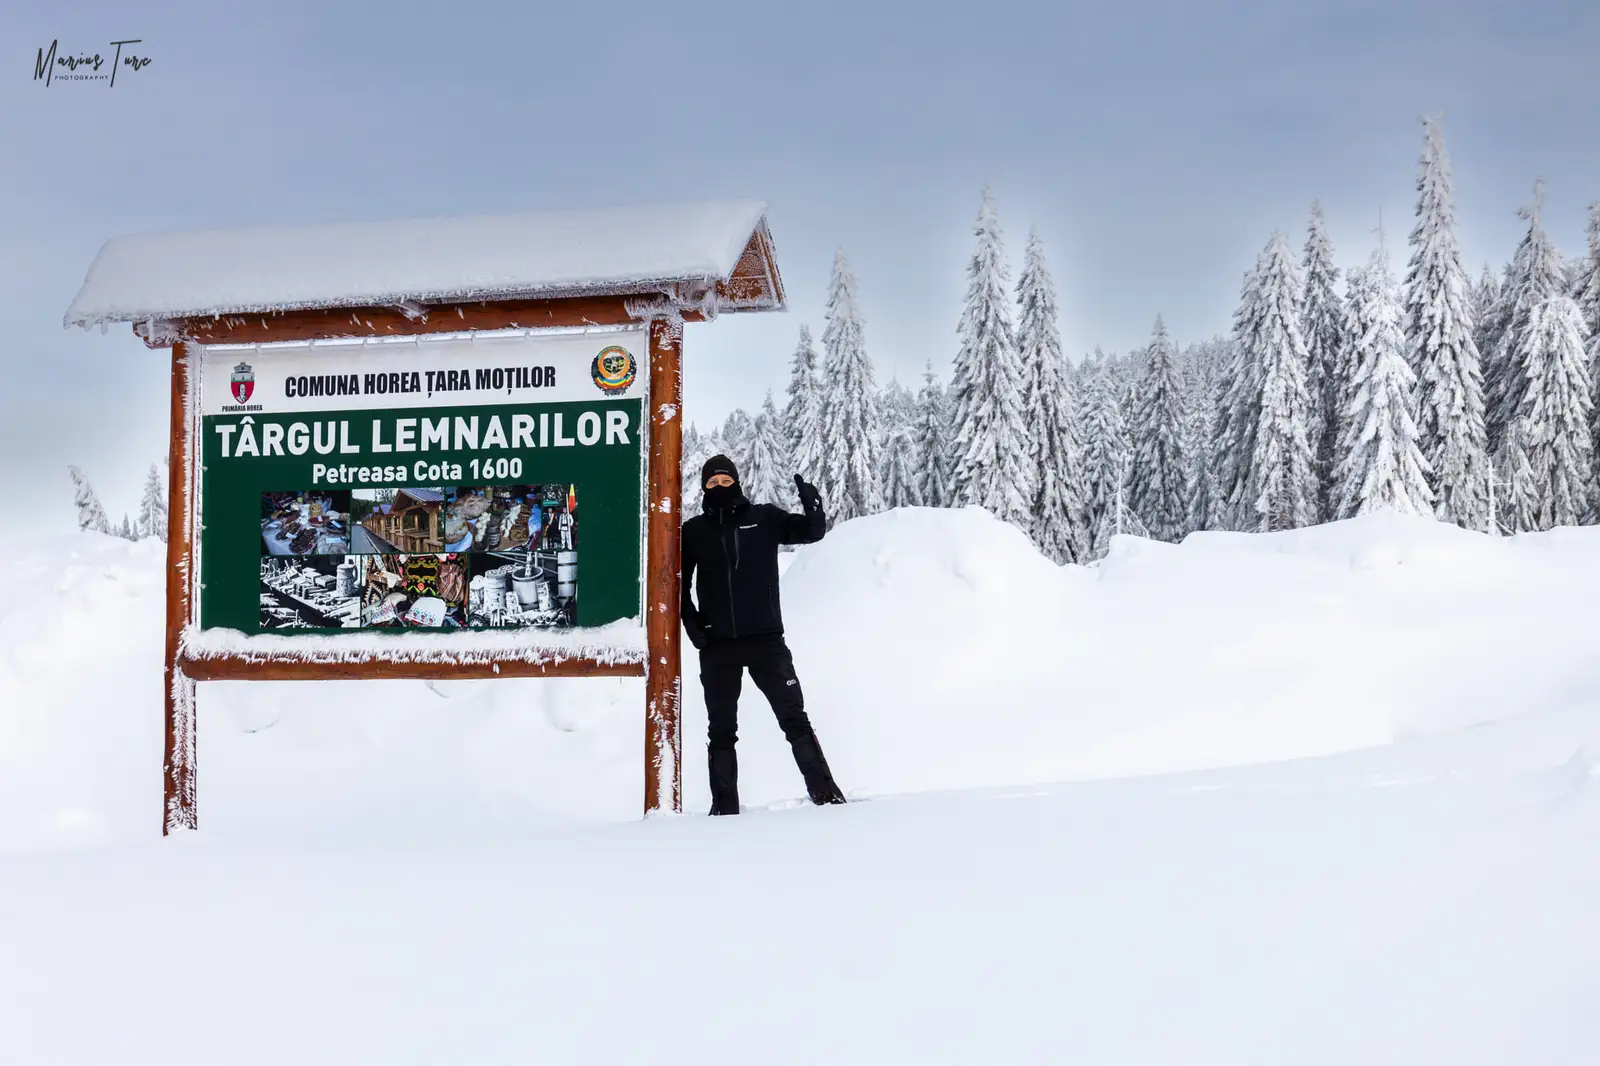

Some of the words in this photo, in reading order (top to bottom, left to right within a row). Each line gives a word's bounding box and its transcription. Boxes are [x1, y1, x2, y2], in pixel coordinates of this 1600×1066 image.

[285, 374, 360, 398] COMUNA
[363, 371, 422, 395] HOREA
[425, 369, 472, 399] ȚARA
[475, 366, 556, 396] MOȚILOR
[215, 415, 360, 458] TÂRGUL
[371, 410, 631, 453] LEMNARILOR
[312, 465, 408, 484] Petreasa
[413, 460, 462, 481] Cota
[469, 457, 523, 480] 1600
